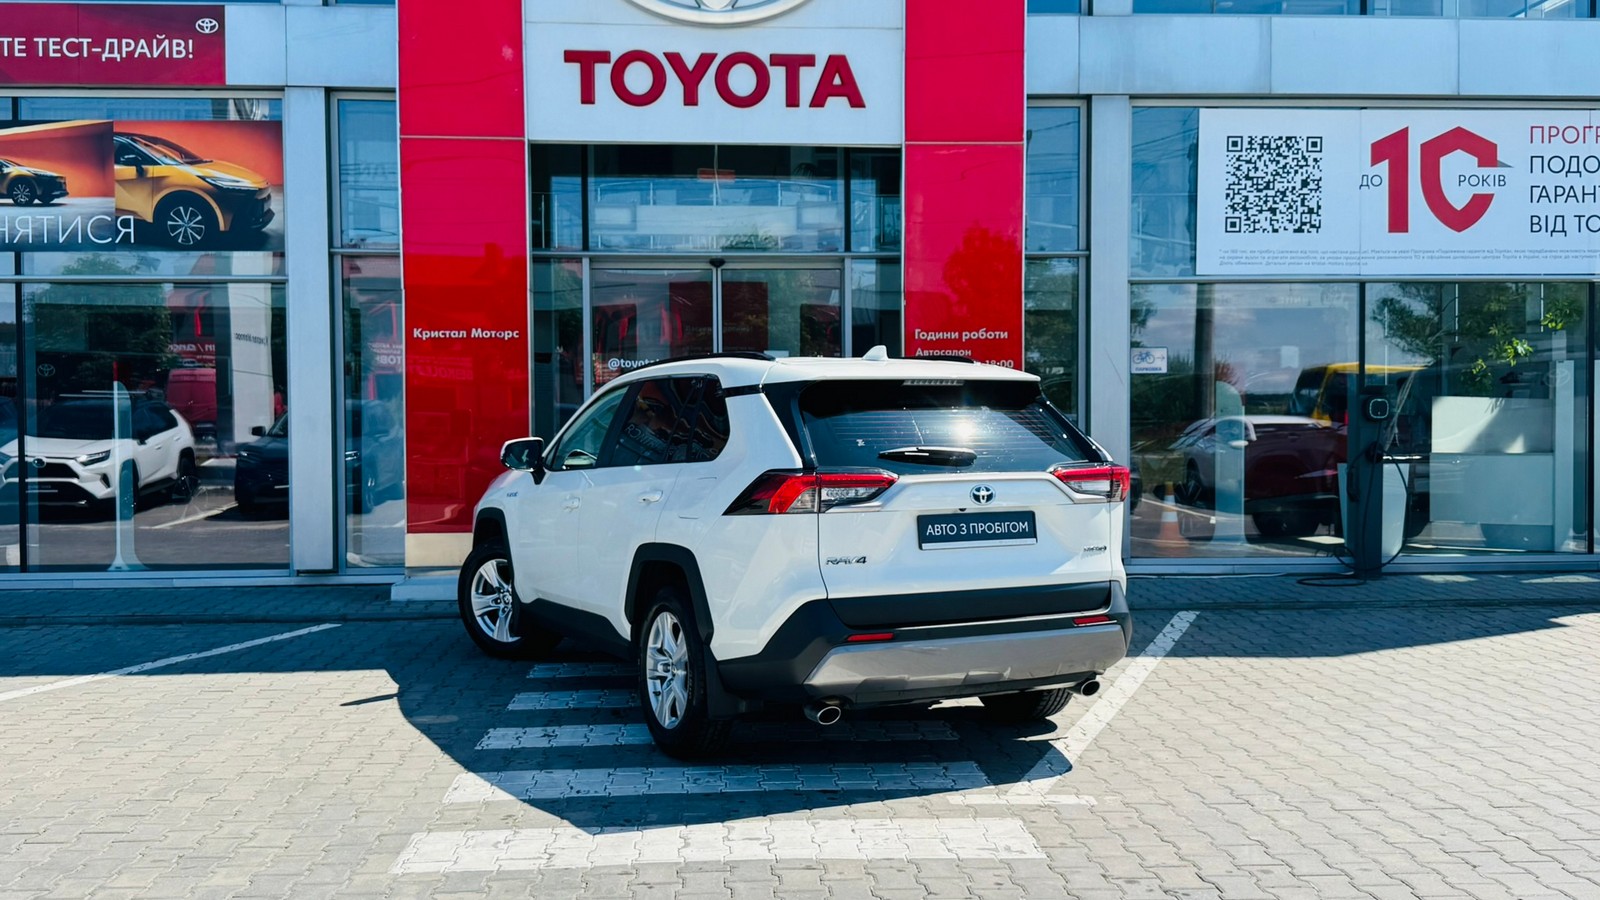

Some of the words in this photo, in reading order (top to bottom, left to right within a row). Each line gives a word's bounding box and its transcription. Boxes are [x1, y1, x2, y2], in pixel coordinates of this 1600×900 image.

[0, 38, 27, 57] ТЕ
[33, 34, 193, 62] ТЕСТ-ДРАЙВ!
[563, 49, 866, 108] TOYOTA
[1359, 174, 1383, 190] ДО
[1458, 174, 1507, 187] РОКІВ
[1530, 185, 1600, 203] ГАРАН
[1530, 215, 1567, 237] ВІД
[413, 328, 467, 340] Кристал
[471, 328, 520, 340] Моторс
[914, 329, 959, 340] Години
[962, 328, 1008, 342] роботи
[915, 348, 972, 356] Автосалон
[926, 524, 957, 536] АВТО
[970, 521, 1029, 534] ПРОБІГОМ
[826, 556, 867, 565] RAV4
